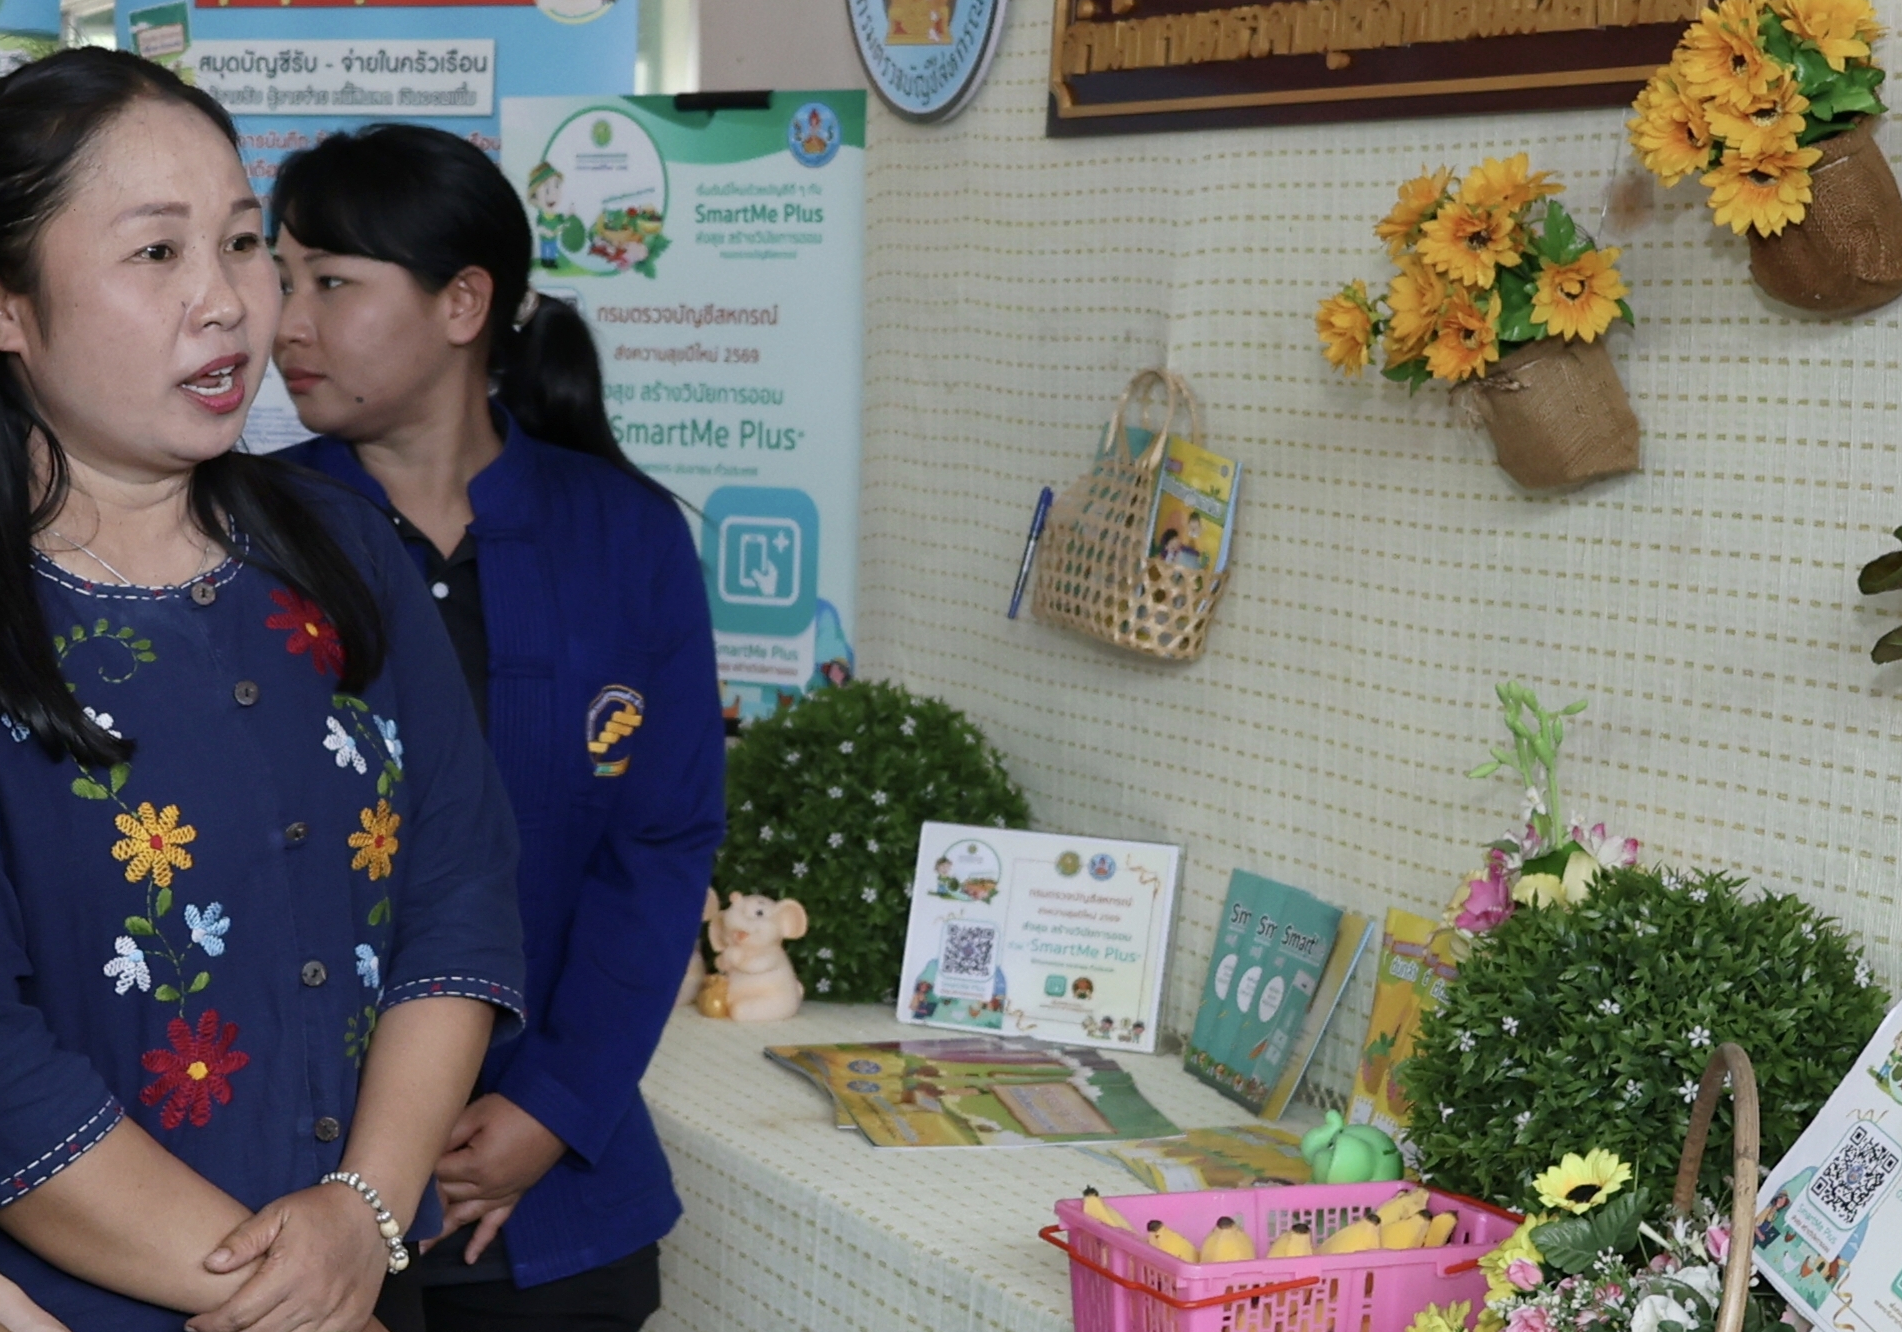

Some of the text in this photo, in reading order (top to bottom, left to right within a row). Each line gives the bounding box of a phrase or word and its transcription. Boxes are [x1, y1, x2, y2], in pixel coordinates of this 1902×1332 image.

[200, 48, 489, 78] สมุดบัญชีรับ จ่ายในครัวเรือน
[695, 204, 823, 225] SmartMe Plus
[597, 303, 779, 328] กรมตรวจบัญชีสหกรณ์
